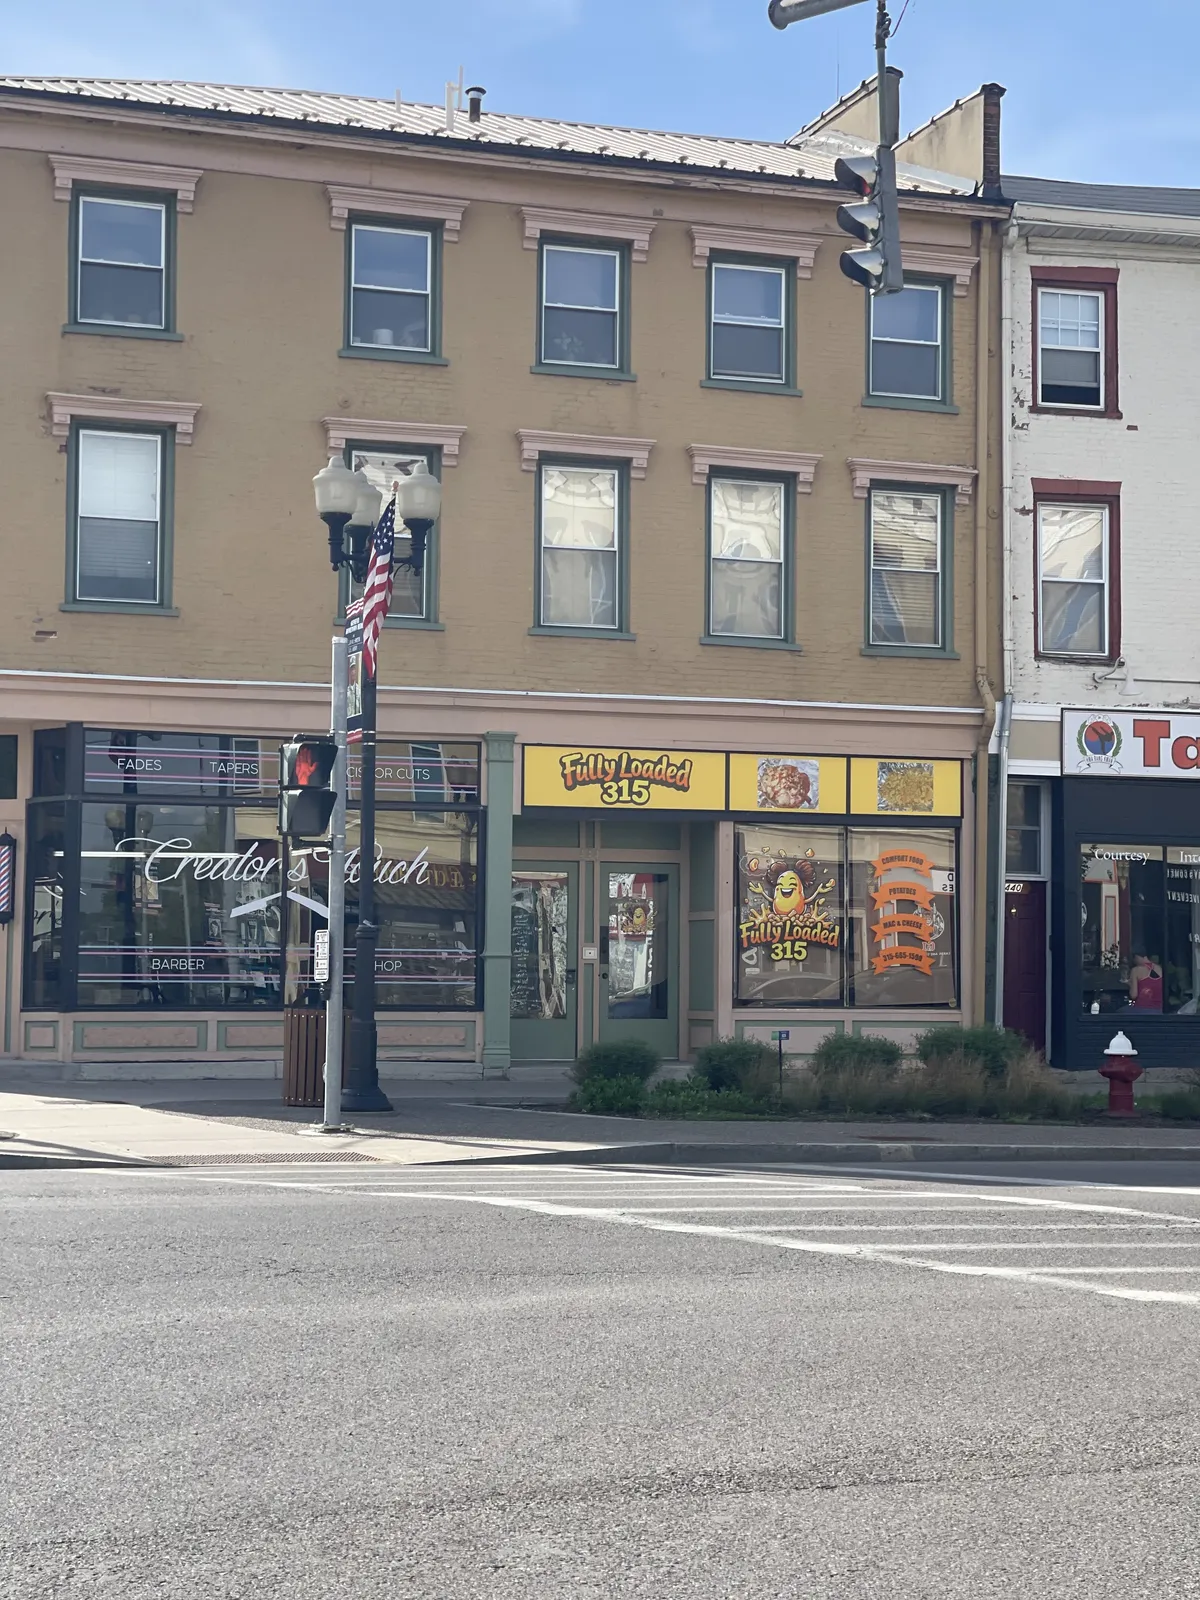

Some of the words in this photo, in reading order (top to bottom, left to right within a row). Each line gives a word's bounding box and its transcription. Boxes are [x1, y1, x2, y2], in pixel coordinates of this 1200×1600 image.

[1133, 718, 1200, 770] Ta
[117, 758, 162, 771] FADES
[209, 761, 259, 774] TAPERS
[559, 752, 616, 790] Fully
[618, 752, 692, 790] Loaded
[396, 768, 430, 780] CUTS
[601, 780, 650, 806] 315
[881, 854, 908, 865] COMFORT
[909, 855, 924, 865] FOOD
[1094, 848, 1150, 865] Courtesy
[888, 887, 917, 895] POTATOES
[1005, 884, 1022, 892] 440
[883, 920, 896, 929] MAC
[901, 920, 923, 930] CHEESE
[740, 921, 781, 947] Fully
[784, 922, 840, 947] Loaded
[770, 941, 807, 960] 315
[151, 958, 205, 971] BARBER
[374, 960, 402, 972] HOP
